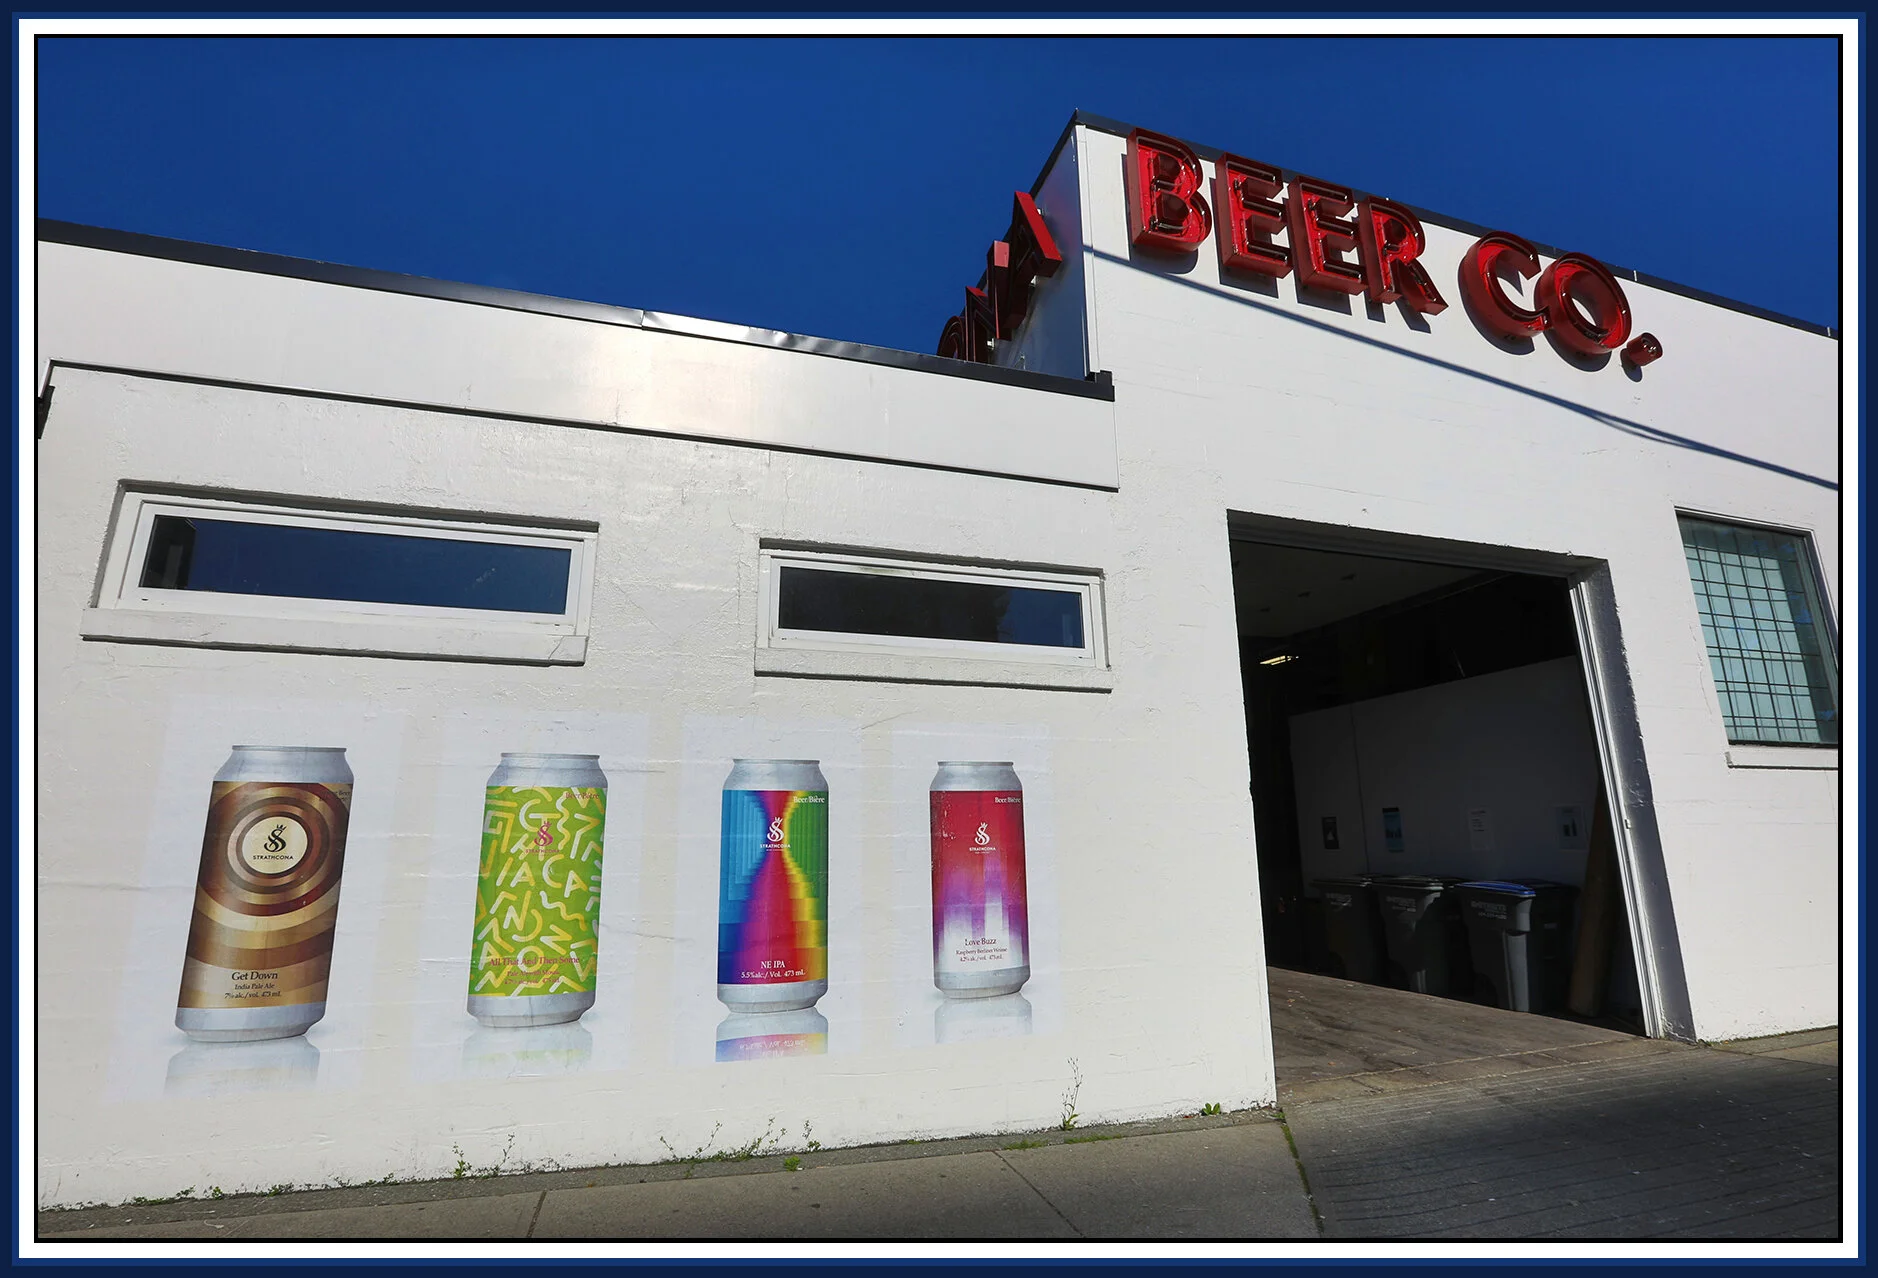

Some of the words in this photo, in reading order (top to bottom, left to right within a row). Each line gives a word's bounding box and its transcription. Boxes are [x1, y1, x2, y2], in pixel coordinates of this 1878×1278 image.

[1127, 128, 1449, 315] BEER
[1463, 231, 1663, 366] CO.
[964, 938, 980, 946] Love
[981, 937, 996, 945] Buzz
[490, 958, 501, 966] All
[503, 957, 518, 965] That
[521, 957, 537, 965] And
[539, 956, 558, 964] Then
[761, 960, 772, 969] NE
[773, 960, 786, 968] IPA
[231, 971, 249, 980] Get
[250, 971, 278, 980] Down
[784, 969, 795, 977] 473
